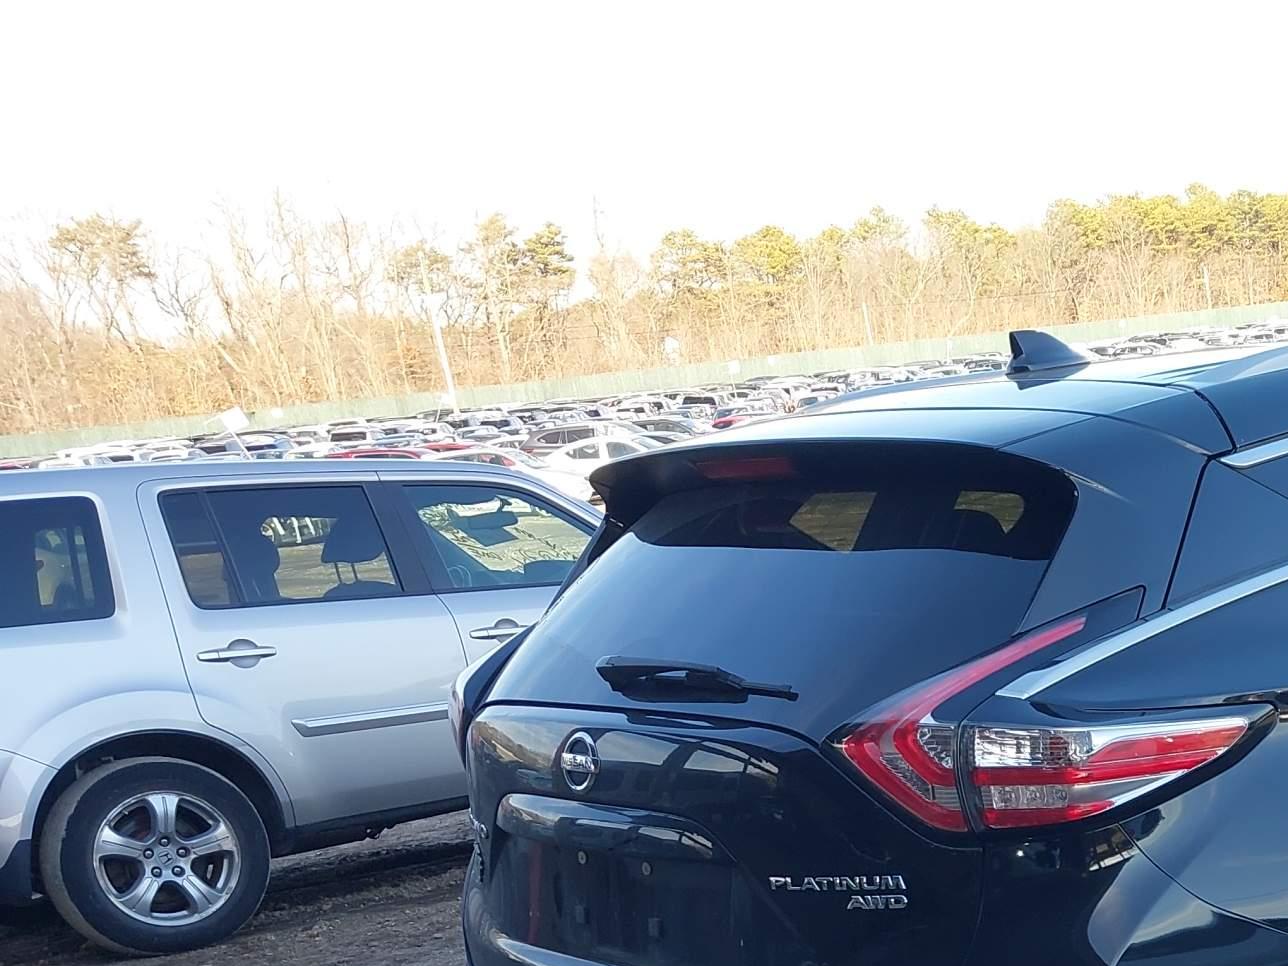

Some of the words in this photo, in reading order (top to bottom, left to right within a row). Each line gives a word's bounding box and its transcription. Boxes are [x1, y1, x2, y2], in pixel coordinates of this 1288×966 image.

[561, 754, 594, 771] NISSAN
[768, 875, 907, 891] PLATINUM
[847, 894, 908, 910] AWD
